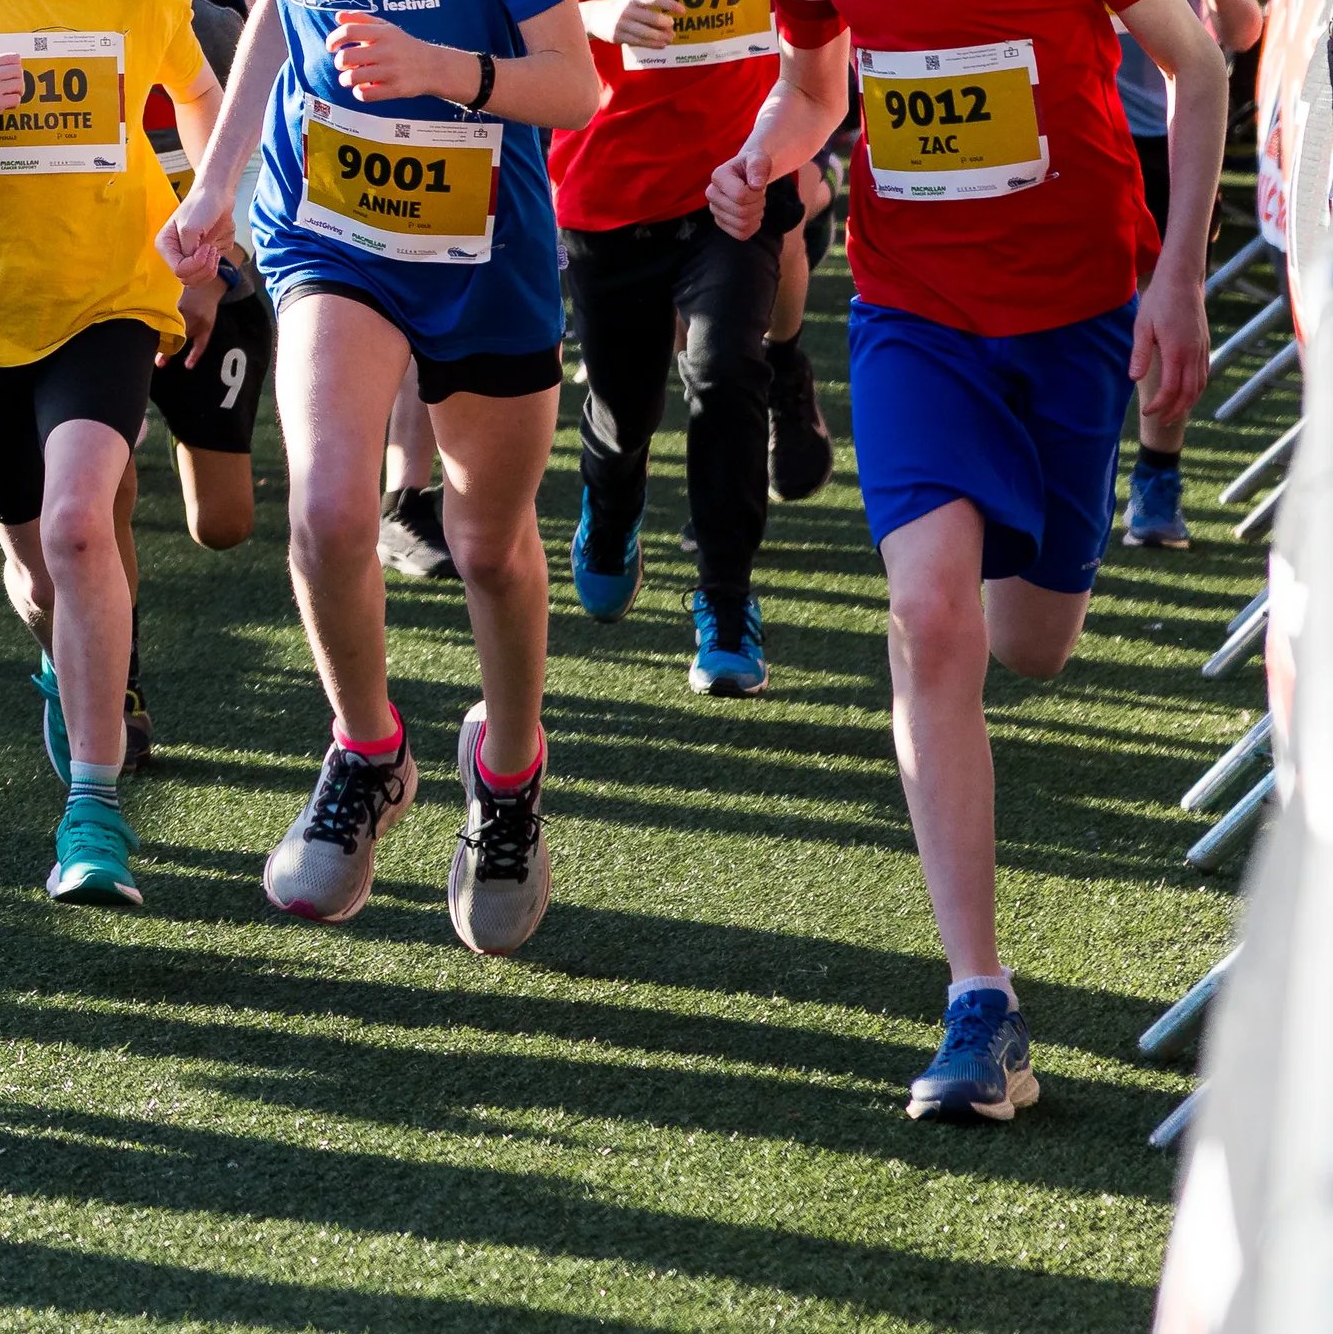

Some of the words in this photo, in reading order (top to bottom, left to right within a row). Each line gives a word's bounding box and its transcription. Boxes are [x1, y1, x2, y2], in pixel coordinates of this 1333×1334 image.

[673, 11, 734, 32] HAMISH
[885, 86, 991, 130] 9012
[918, 135, 959, 155] ZAC
[337, 145, 451, 192] 9001
[358, 192, 422, 218] ANNIE
[307, 217, 343, 235] JustGiving
[352, 233, 386, 248] MACMILLAN
[220, 348, 247, 409] 9
